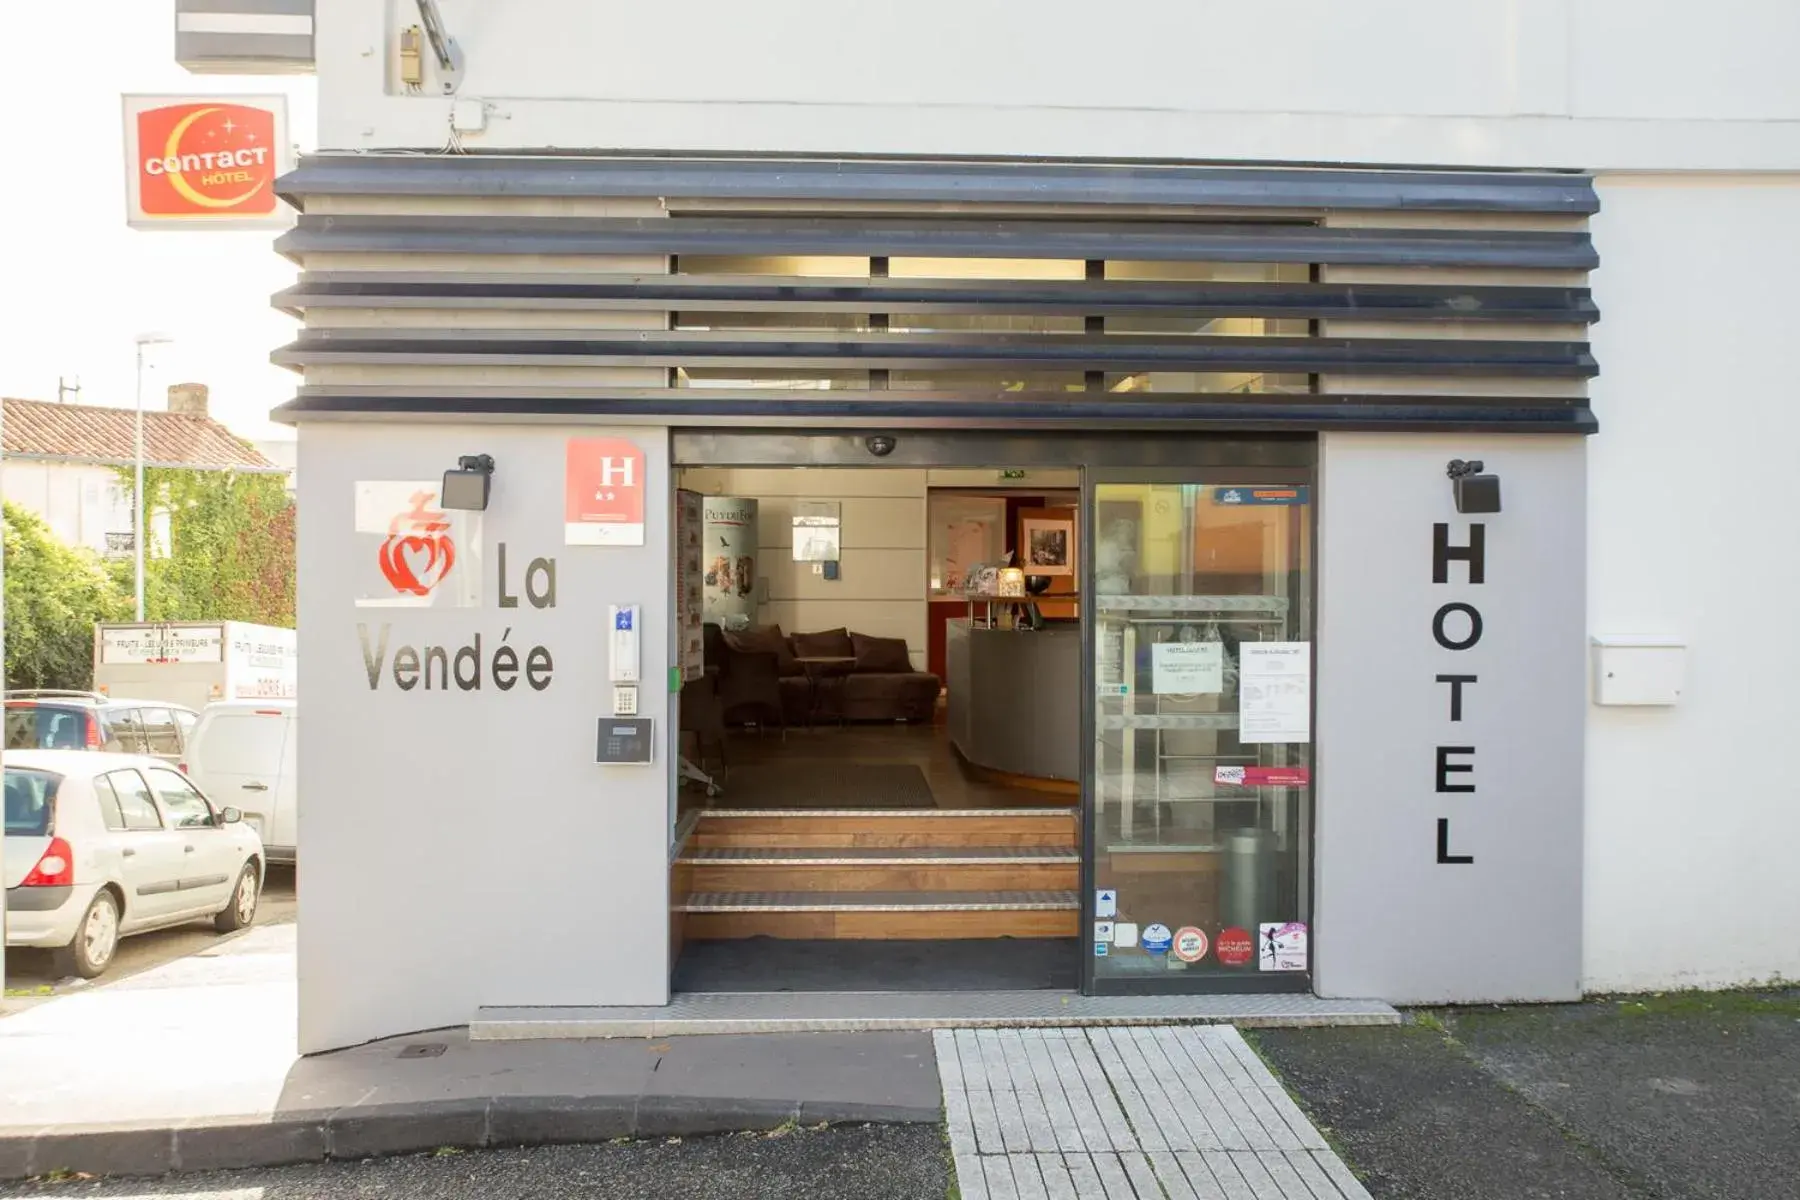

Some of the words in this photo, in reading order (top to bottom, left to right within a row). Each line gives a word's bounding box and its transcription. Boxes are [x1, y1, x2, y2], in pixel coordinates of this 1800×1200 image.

[600, 456, 636, 487] H
[498, 542, 557, 609] La
[356, 622, 554, 692] Vendée
[1432, 523, 1485, 864] HOTEL
